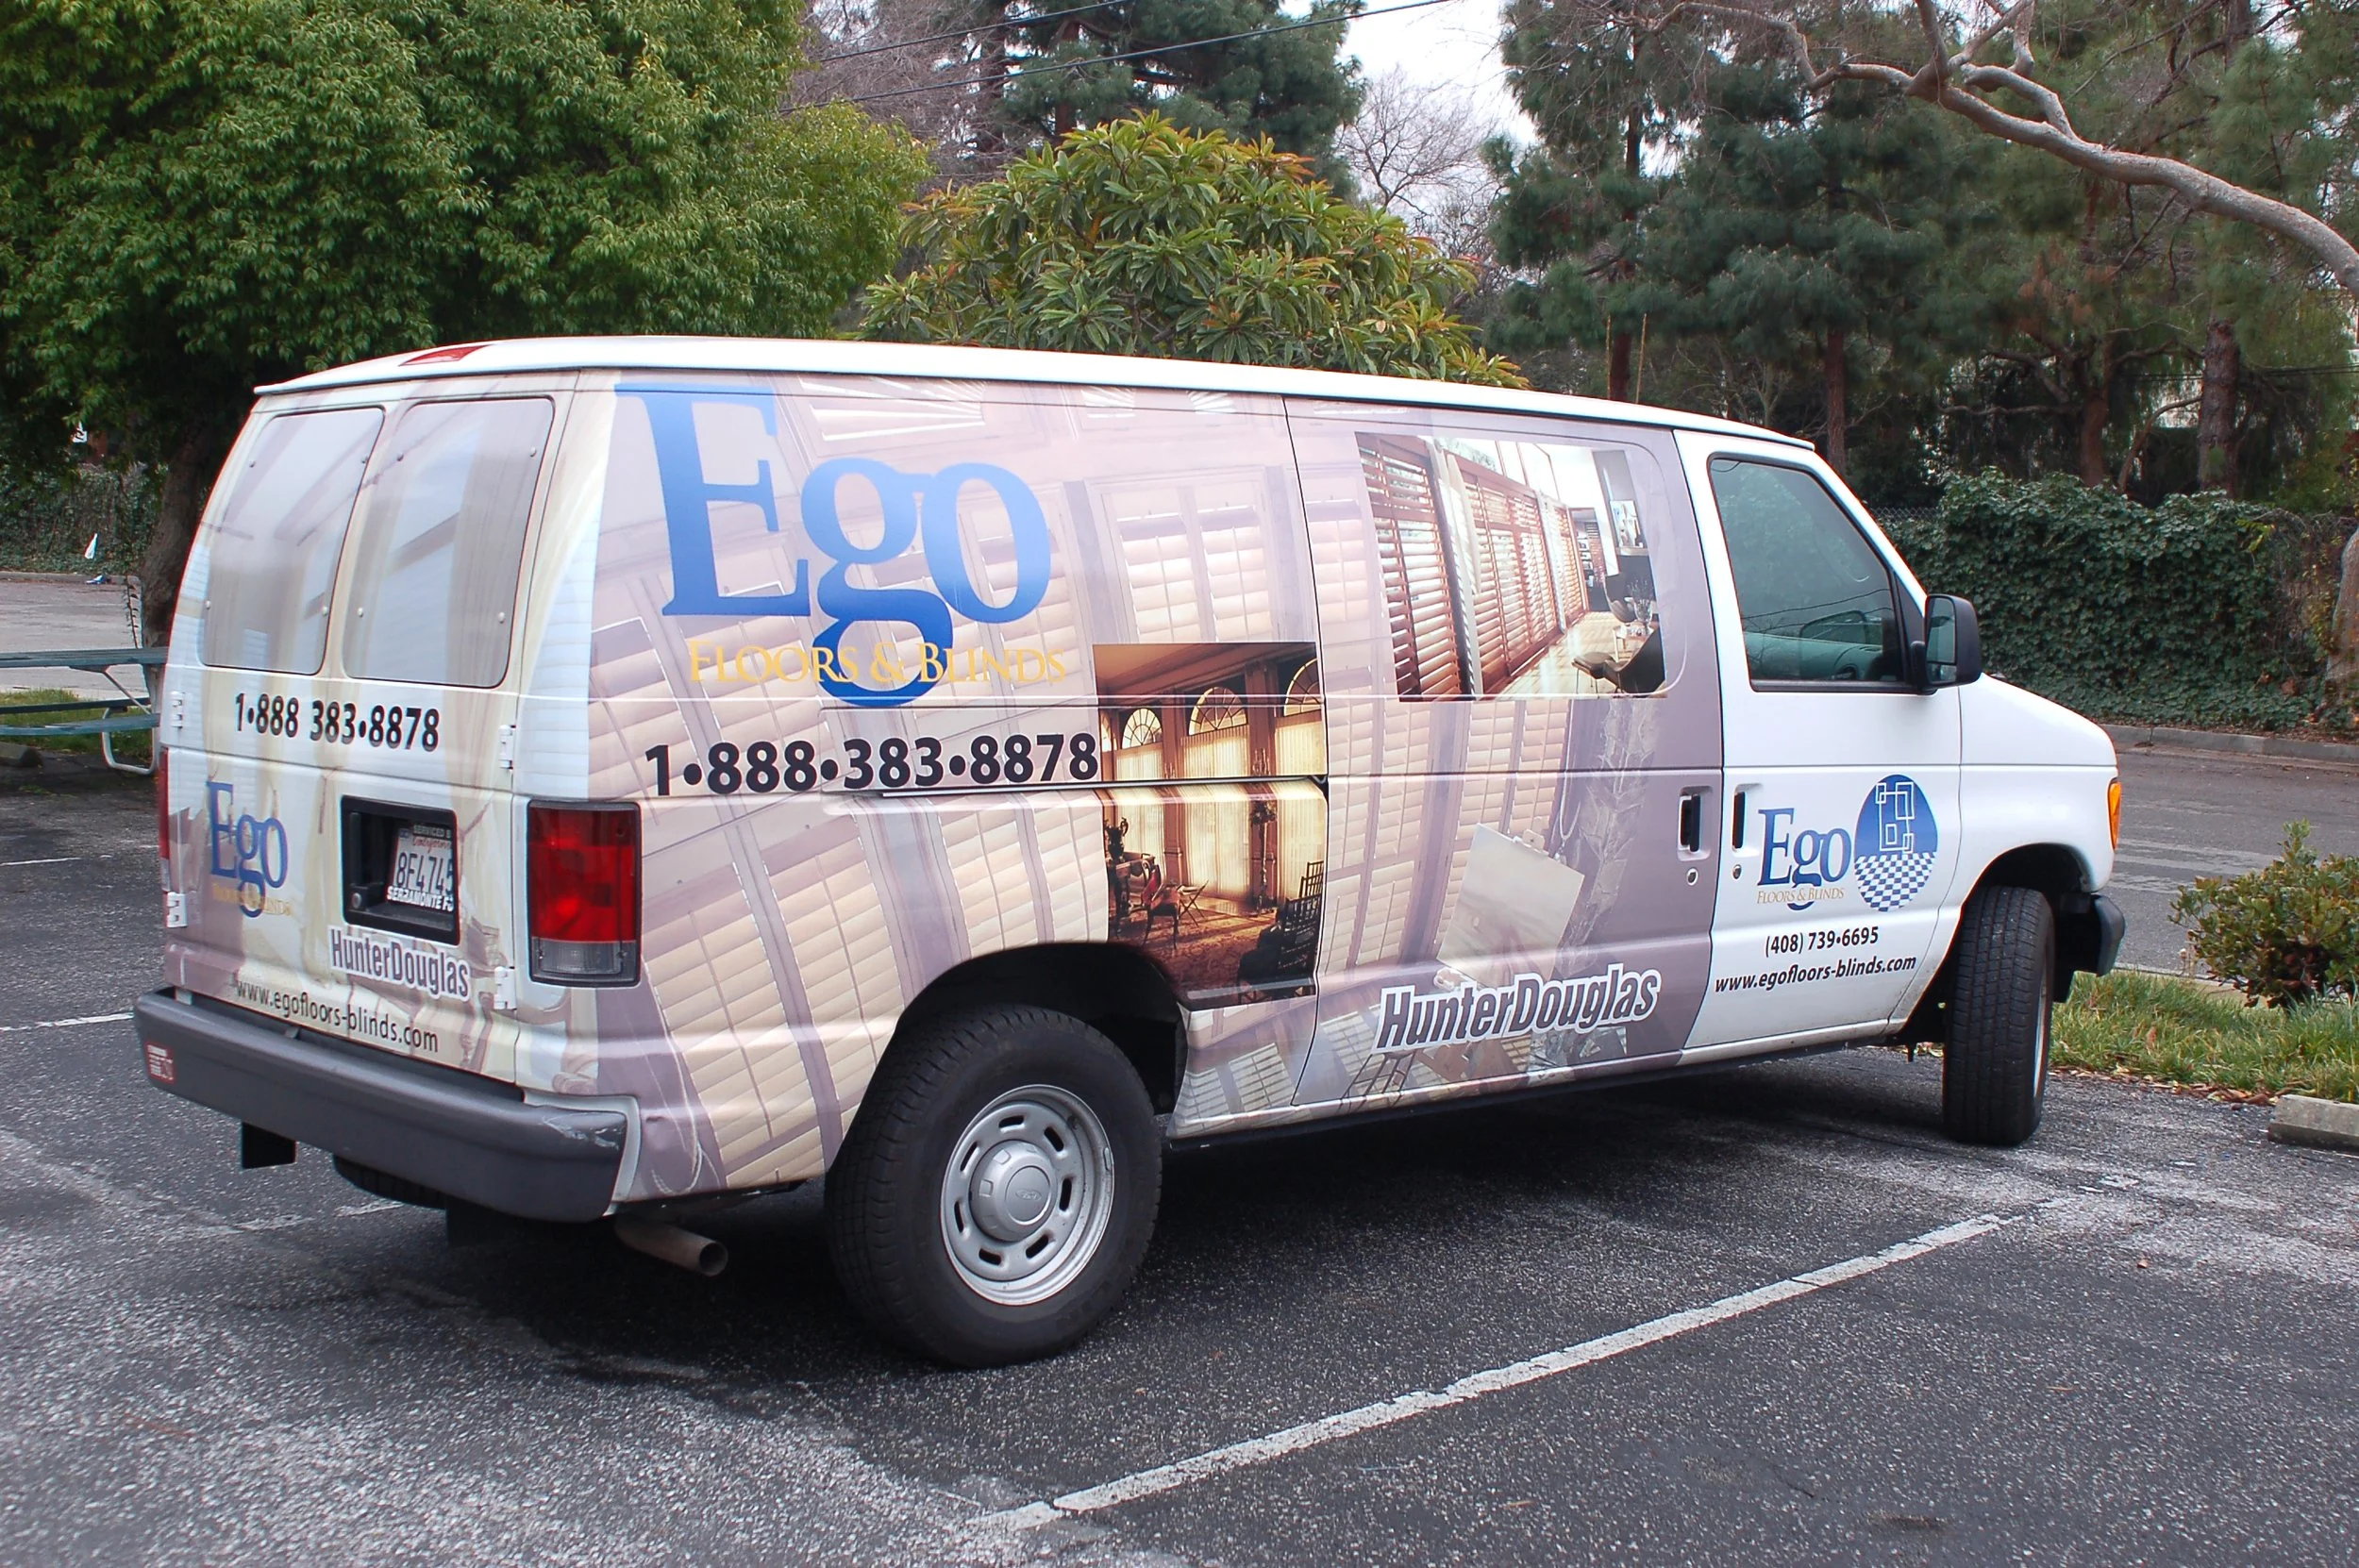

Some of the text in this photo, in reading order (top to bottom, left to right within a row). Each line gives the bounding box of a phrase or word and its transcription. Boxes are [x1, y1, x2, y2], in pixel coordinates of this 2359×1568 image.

[614, 383, 1051, 707] Ego
[688, 641, 1065, 683] FLOORS & BLINDS
[206, 780, 289, 919] Ego
[1757, 808, 1852, 911] Ego
[1757, 890, 1796, 904] FLOORS
[1808, 887, 1845, 901] BLINDS
[1715, 955, 1916, 992] www.egofloors-blinds.com
[1765, 932, 1804, 958] (408)
[236, 980, 439, 1053] www.egofloors-blinds.com
